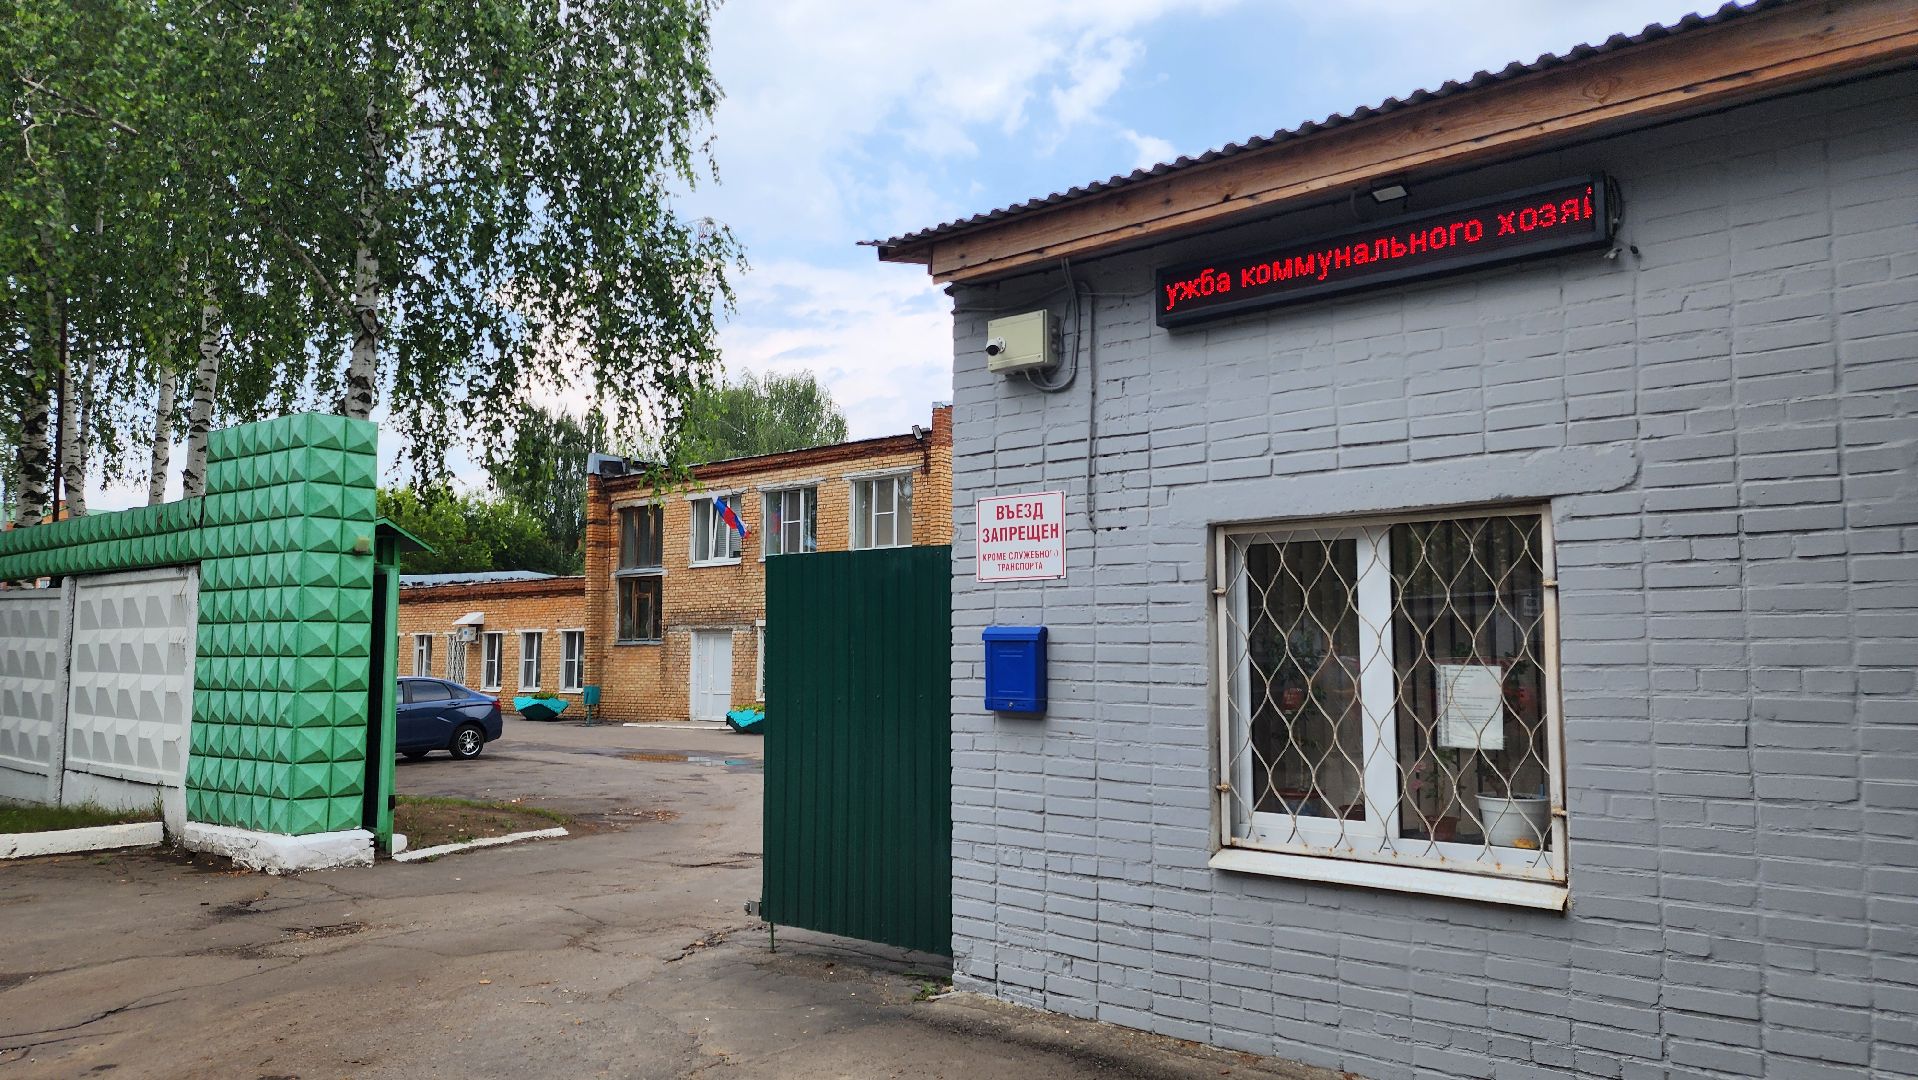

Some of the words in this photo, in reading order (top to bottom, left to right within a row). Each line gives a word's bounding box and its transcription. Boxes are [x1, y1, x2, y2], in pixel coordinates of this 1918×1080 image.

[1166, 268, 1231, 310] ужба
[1241, 219, 1483, 287] коммунального
[996, 502, 1043, 520] ВЪЕЗД
[982, 523, 1059, 543] ЗАПРЕЩЕН
[982, 552, 1007, 562] КРОМЕ
[997, 561, 1043, 572] ТРАНСПОРТА
